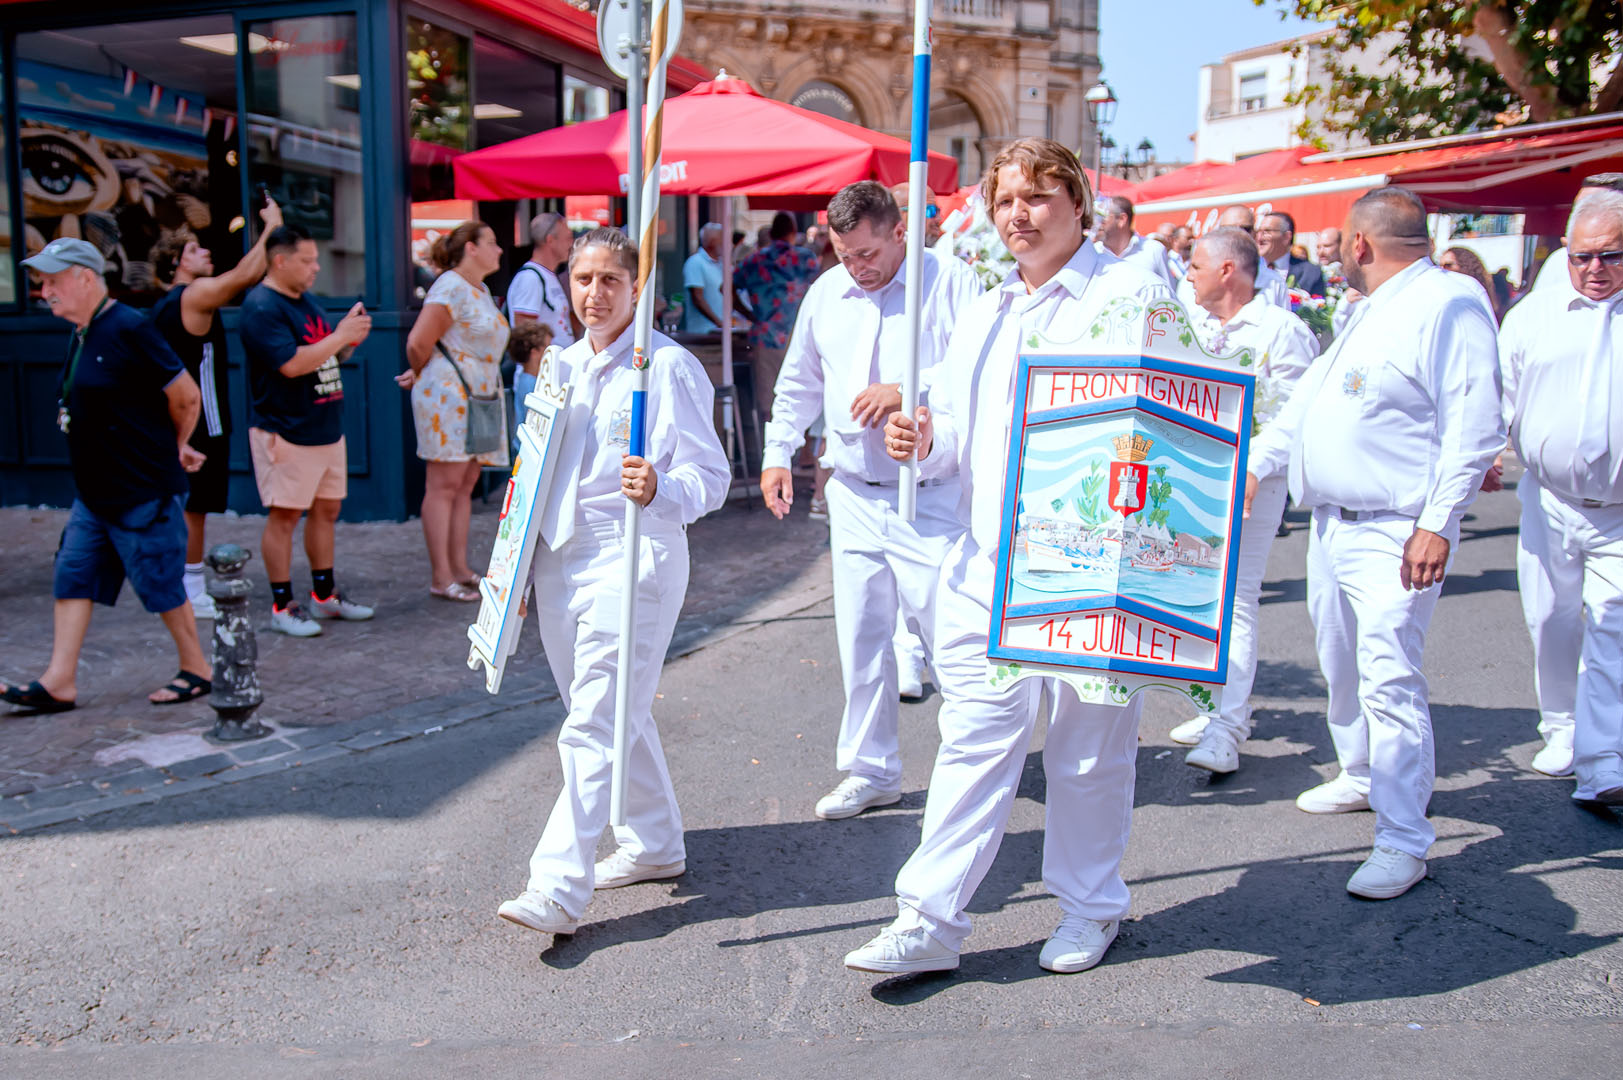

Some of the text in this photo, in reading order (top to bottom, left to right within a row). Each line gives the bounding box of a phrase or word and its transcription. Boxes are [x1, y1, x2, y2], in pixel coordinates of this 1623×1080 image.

[1050, 372, 1220, 422] FRONTIGNAN
[1039, 613, 1182, 662] 14 JUILLET
